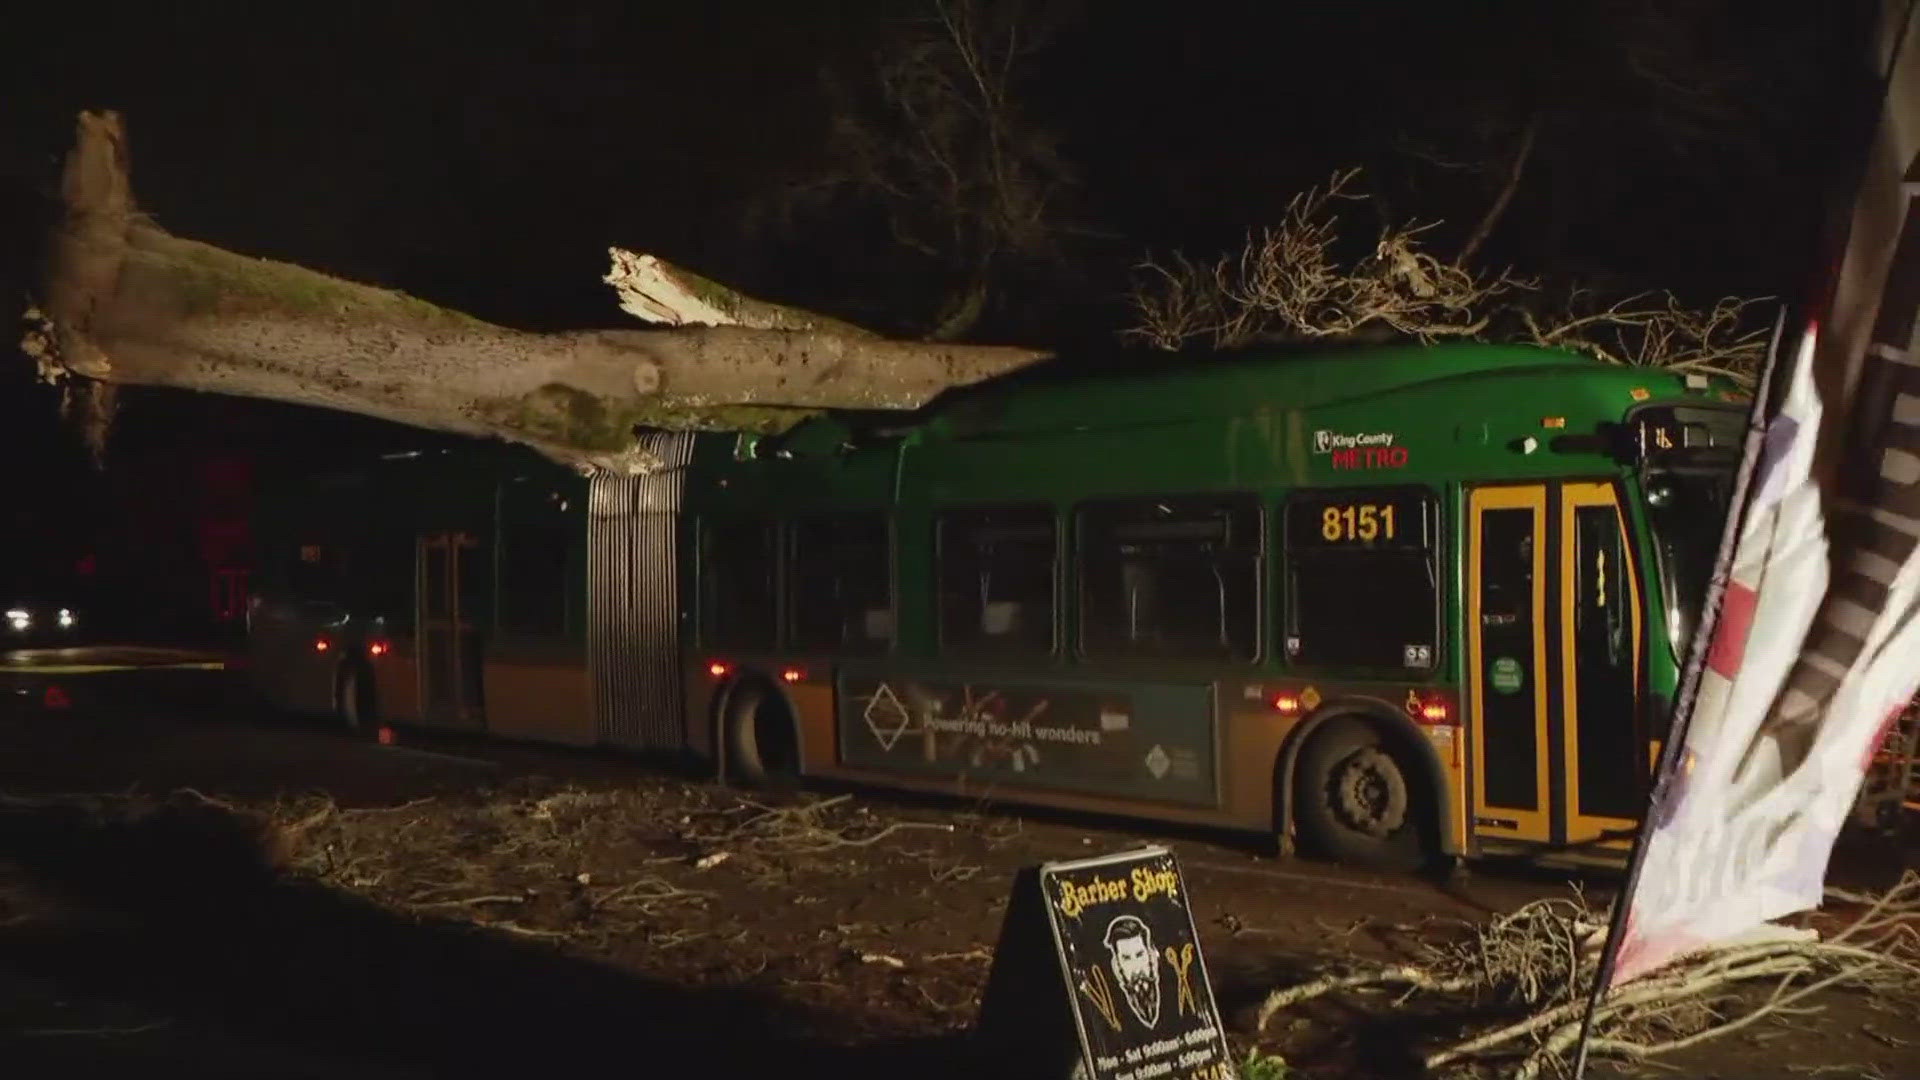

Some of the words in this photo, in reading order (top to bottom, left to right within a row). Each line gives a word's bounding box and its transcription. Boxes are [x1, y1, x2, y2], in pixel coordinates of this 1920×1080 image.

[1332, 433, 1356, 448] King
[1356, 432, 1394, 447] County
[1332, 447, 1408, 469] METRO
[1322, 504, 1395, 541] 8151
[924, 711, 986, 737] Powering
[1035, 724, 1101, 745] wonders
[1060, 875, 1128, 918] Barber
[1131, 866, 1178, 902] Shop
